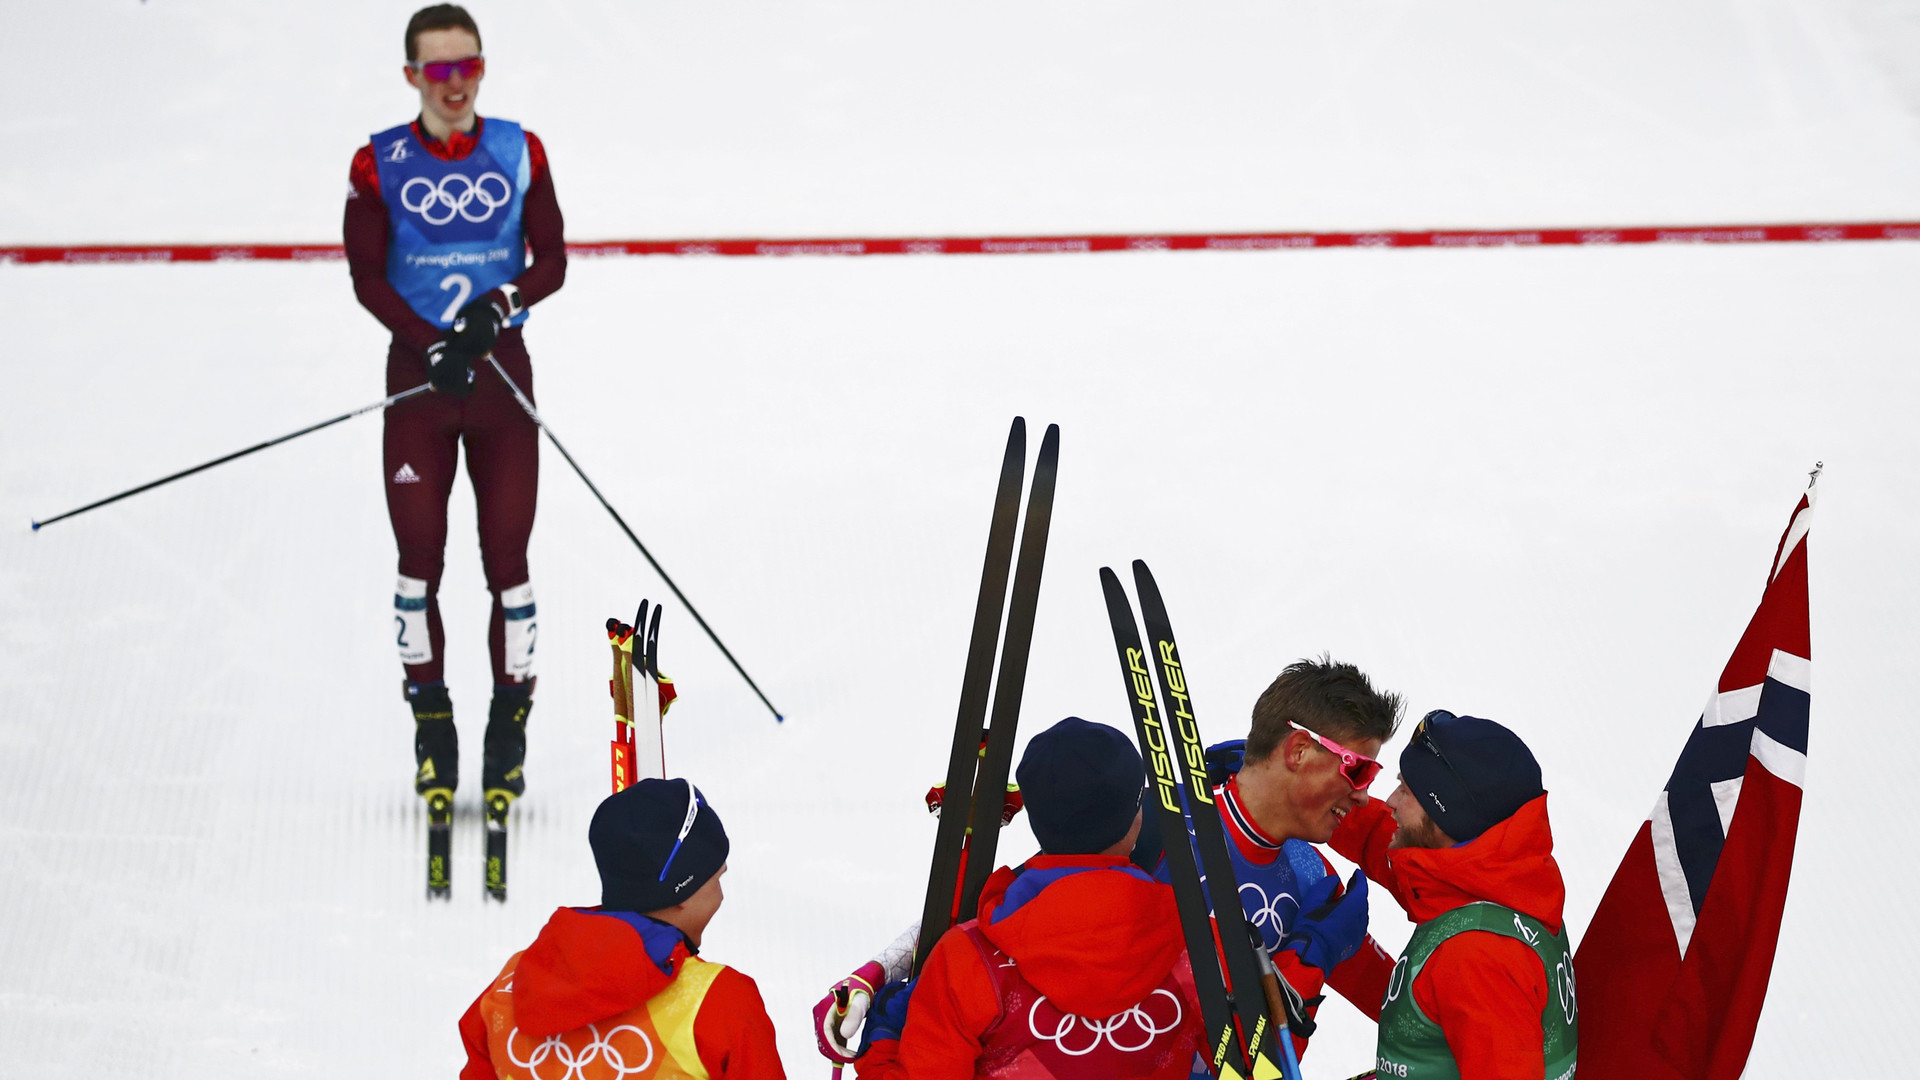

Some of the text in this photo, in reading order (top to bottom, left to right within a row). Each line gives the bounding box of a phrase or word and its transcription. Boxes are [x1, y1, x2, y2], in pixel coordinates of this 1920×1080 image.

[440, 273, 473, 323] 2
[395, 615, 409, 648] 2
[1126, 647, 1181, 814] FISCHER
[1158, 640, 1214, 805] FISCHER
[1213, 1023, 1233, 1069] SPEED MAX
[1248, 1013, 1267, 1059] SPEED MAX
[1380, 1056, 1408, 1078] 2018
